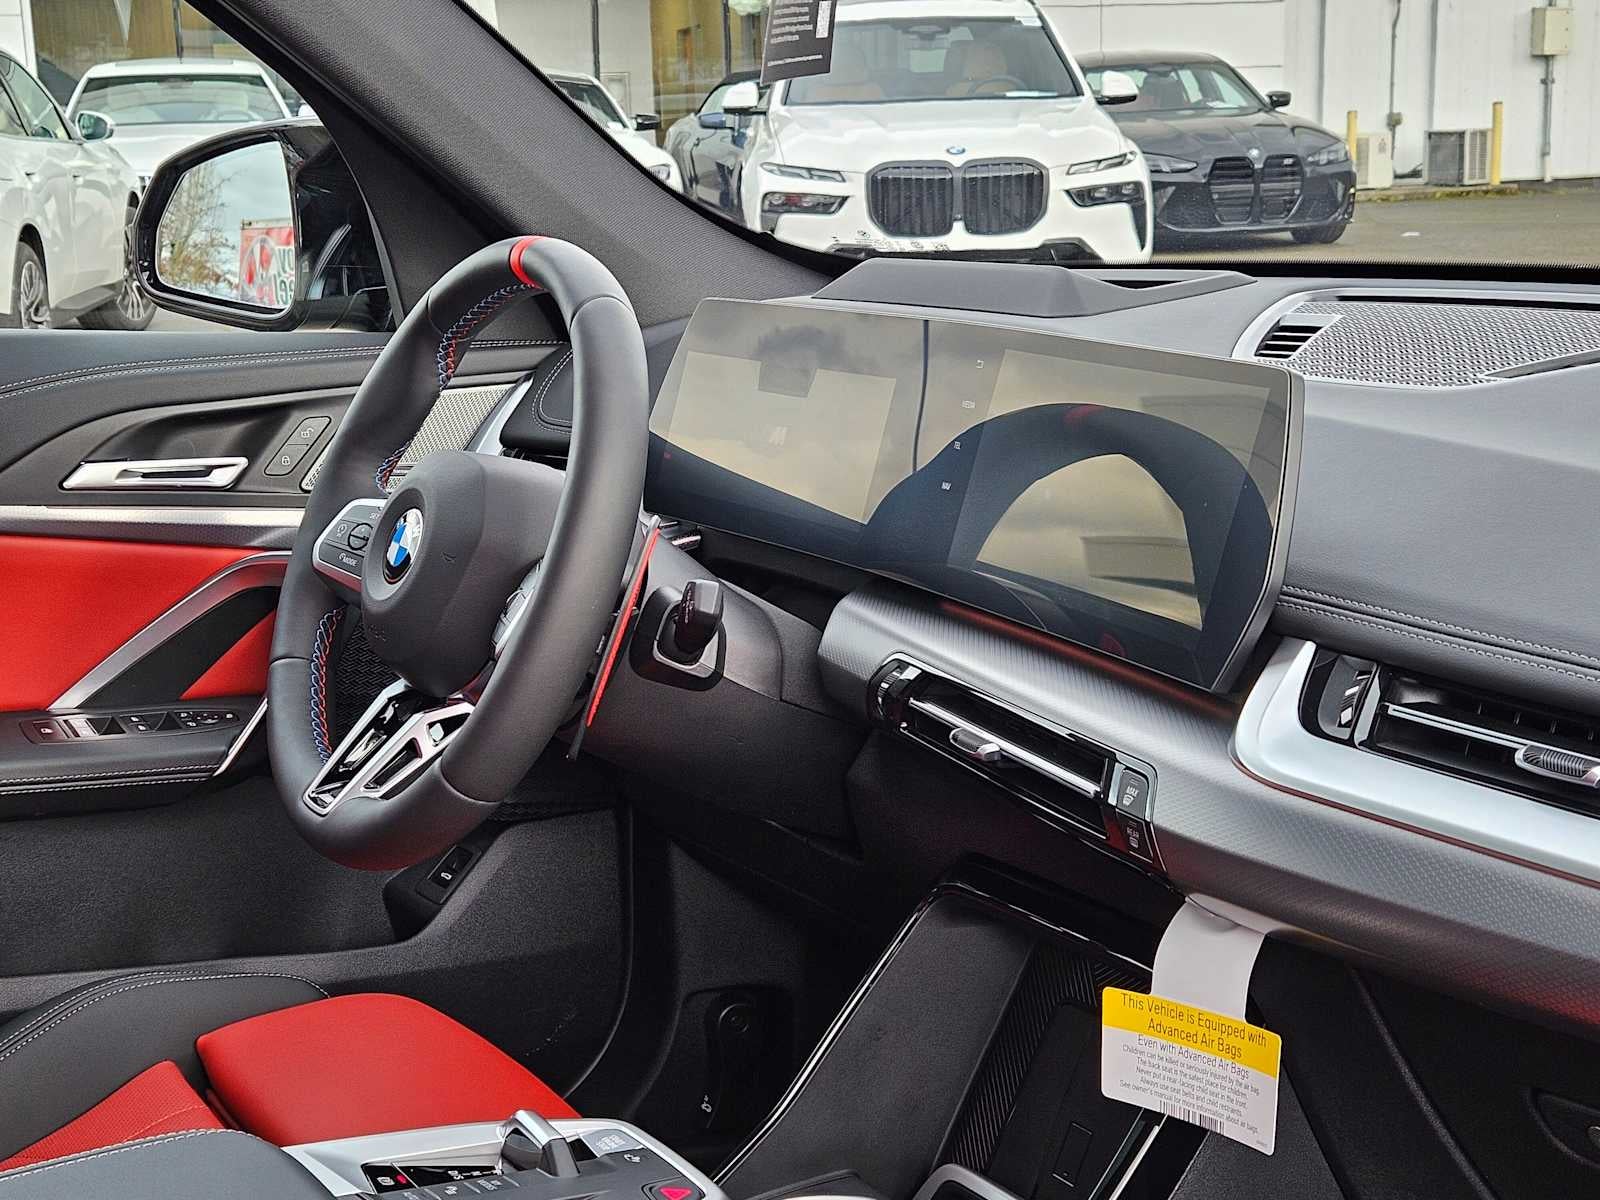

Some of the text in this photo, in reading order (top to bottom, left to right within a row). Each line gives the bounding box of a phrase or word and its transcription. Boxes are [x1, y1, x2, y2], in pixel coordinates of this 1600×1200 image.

[1120, 992, 1267, 1048] This Vehicle is Equipped with
[1147, 1018, 1242, 1060] Advanced Air Bags
[1122, 1043, 1146, 1057] Children
[1147, 1051, 1157, 1060] can
[1157, 1053, 1165, 1062] be
[1165, 1056, 1179, 1067] killed
[1186, 1062, 1209, 1077] seriously
[1209, 1068, 1228, 1082] injured
[1228, 1075, 1234, 1087] by
[1235, 1078, 1243, 1087] the
[1137, 1034, 1249, 1080] Even with Advanced Air Bags
[1137, 1056, 1147, 1066] The
[1148, 1059, 1161, 1070] back
[1161, 1065, 1173, 1075] seat
[1179, 1069, 1188, 1079] the
[1188, 1073, 1204, 1084] safest
[1204, 1078, 1219, 1089] place
[1120, 1079, 1131, 1089] See
[1153, 1090, 1172, 1101] manual
[1173, 1095, 1181, 1104] for
[1182, 1099, 1195, 1109] more
[1196, 1103, 1225, 1119] information
[1225, 1113, 1240, 1125] about
[1136, 1065, 1152, 1076] Never
[1152, 1072, 1162, 1081] put
[1196, 1085, 1208, 1095] child
[1208, 1089, 1220, 1099] seat
[1226, 1094, 1235, 1105] the
[1140, 1076, 1159, 1089] Always
[1159, 1084, 1169, 1092] use
[1170, 1086, 1181, 1095] seat
[1182, 1088, 1195, 1100] belts
[1195, 1094, 1205, 1104] and
[1206, 1098, 1218, 1108] child
